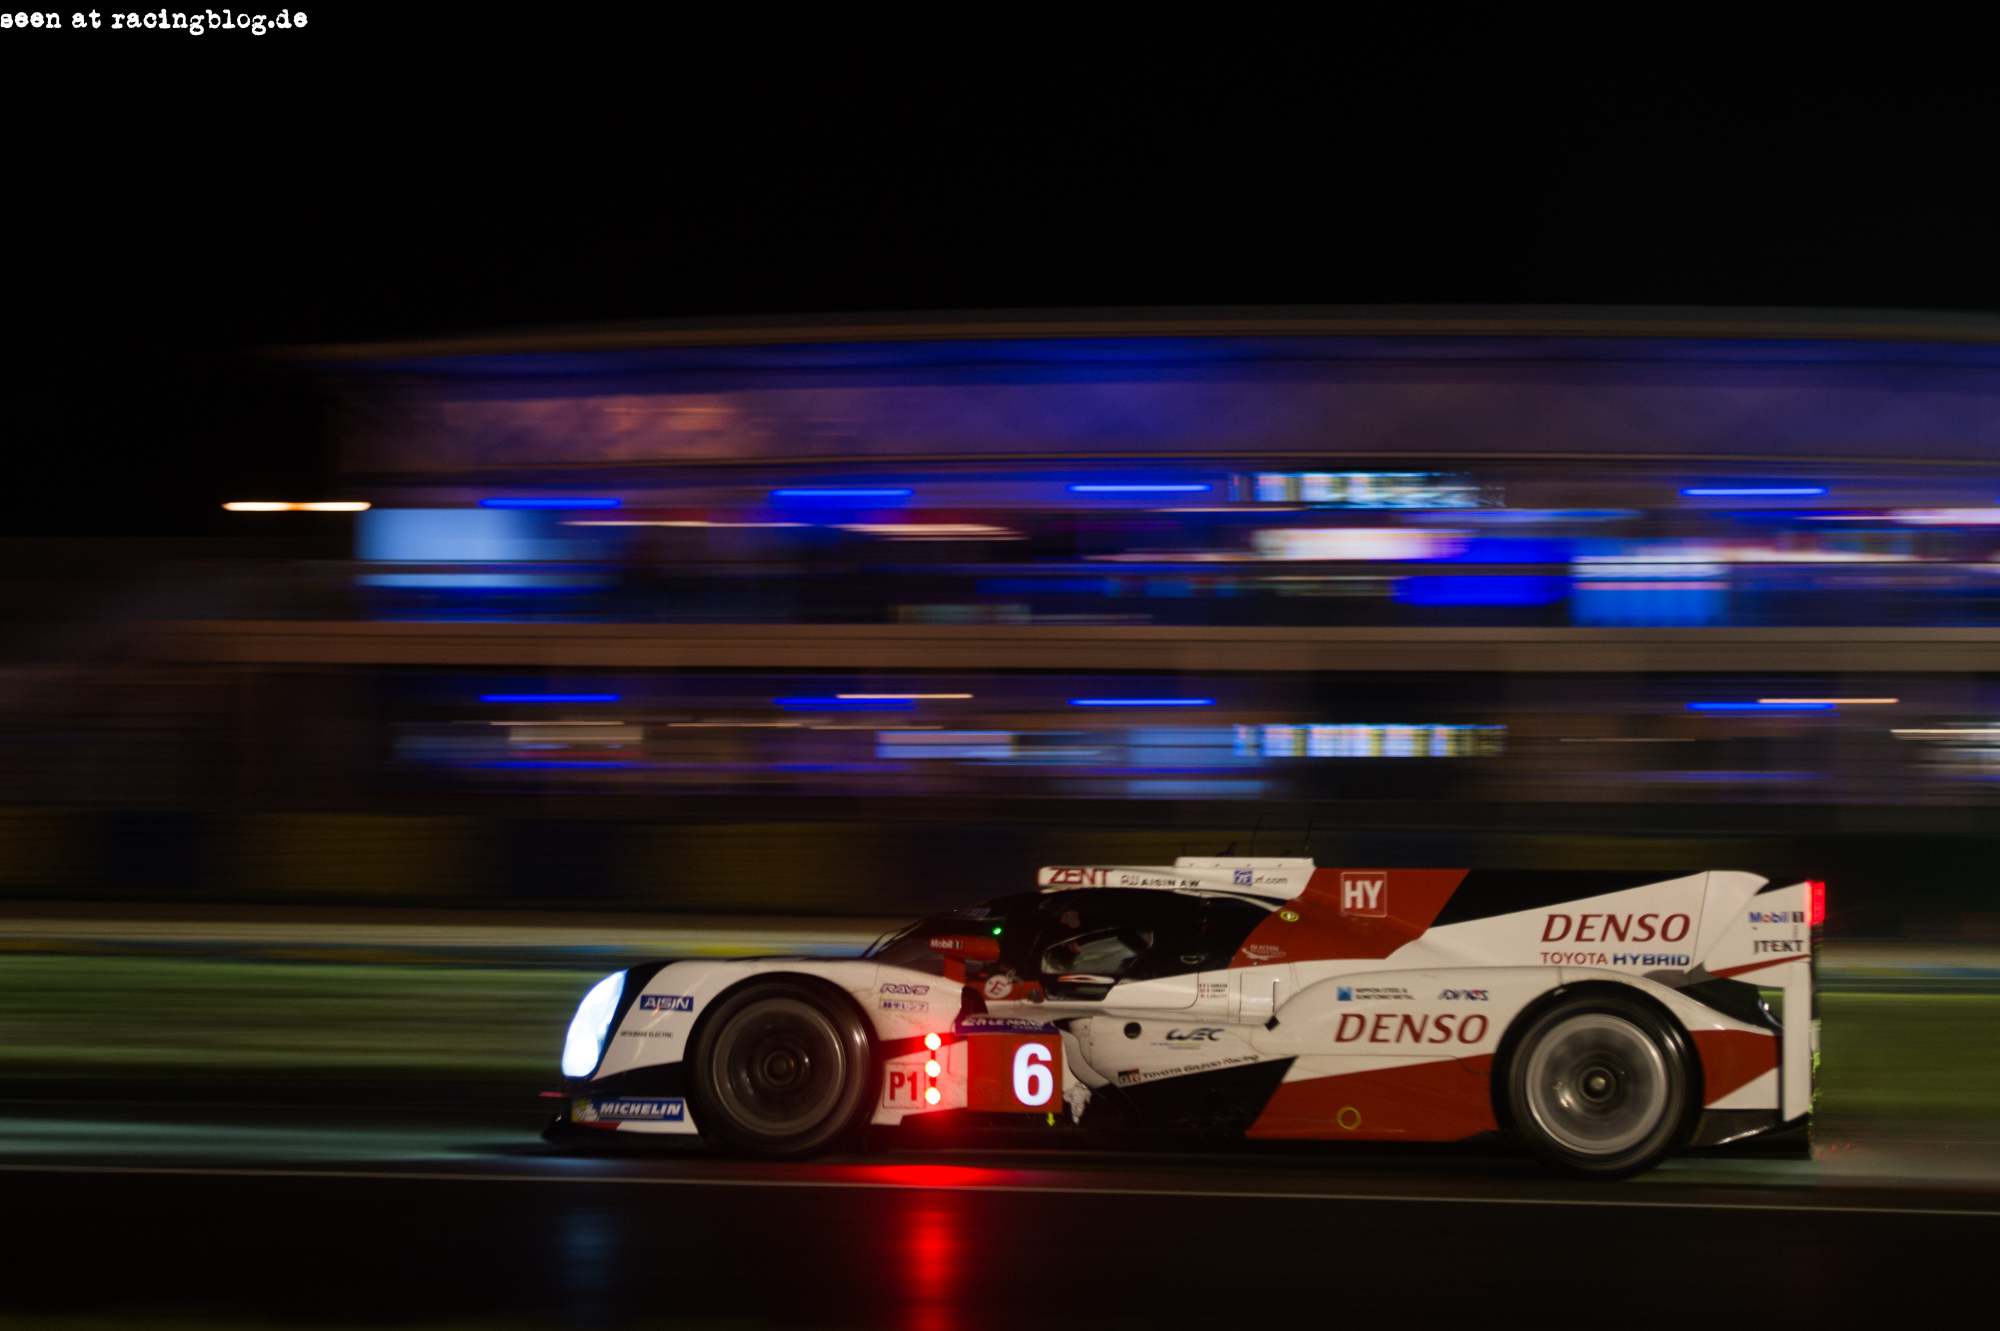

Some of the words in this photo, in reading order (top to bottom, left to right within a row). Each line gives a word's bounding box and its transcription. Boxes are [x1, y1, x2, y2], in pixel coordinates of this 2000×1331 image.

[1049, 867, 1113, 886] ZENT
[1344, 880, 1383, 909] HY
[1541, 913, 1691, 942] DENSO
[1540, 952, 1608, 965] TOYOTA
[1612, 953, 1690, 966] HYBRID
[1753, 940, 1803, 954] JTEKT
[644, 997, 690, 1009] AISIN
[1334, 1013, 1488, 1044] DENSO
[1013, 1042, 1054, 1106] 6
[889, 1072, 918, 1101] P1
[600, 1102, 681, 1116] MICHELIN
